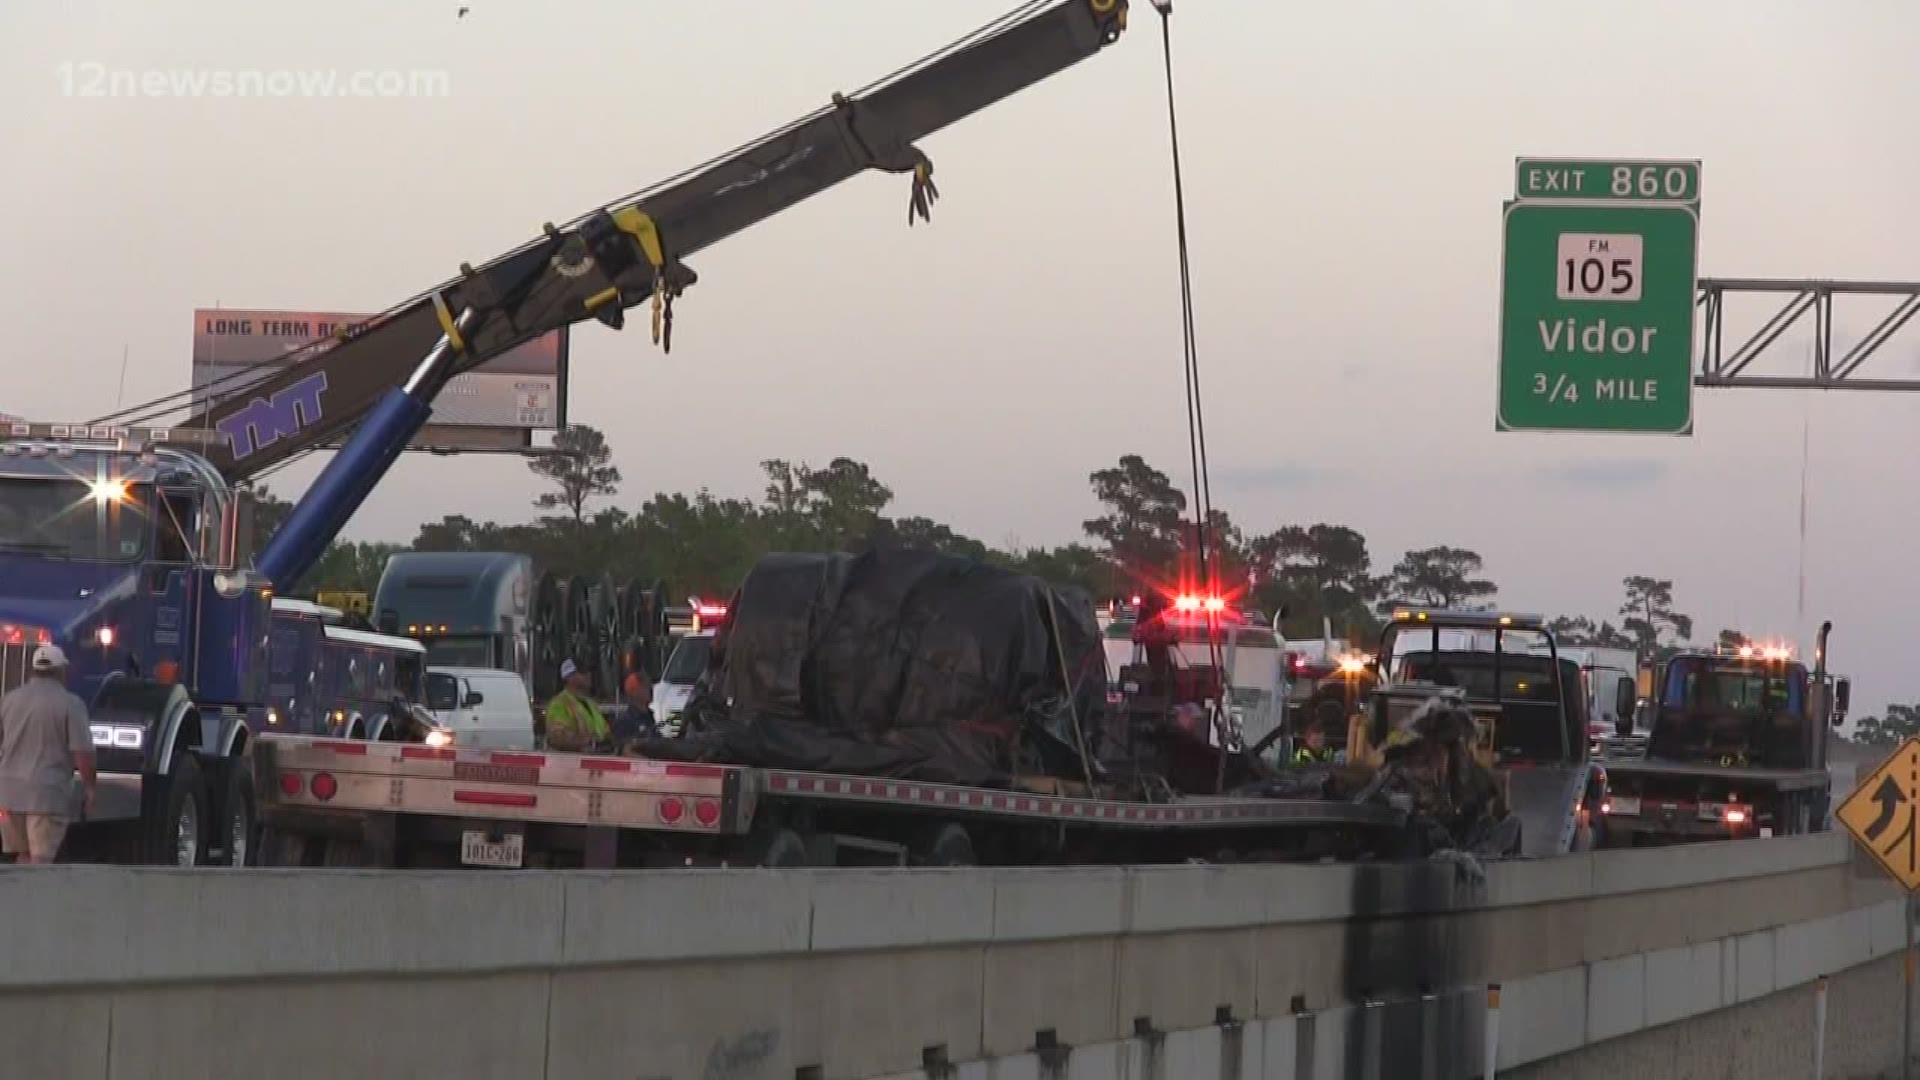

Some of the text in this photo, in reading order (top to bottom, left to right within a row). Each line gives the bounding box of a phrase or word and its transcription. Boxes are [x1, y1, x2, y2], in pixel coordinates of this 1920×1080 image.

[1529, 167, 1687, 198] EXIT 860
[1565, 258, 1634, 295] 105
[206, 318, 252, 336] LONG
[261, 320, 309, 337] TERM
[1538, 318, 1658, 354] Vidor
[1533, 373, 1658, 403] 3/4 MILE
[216, 371, 328, 461] TNT
